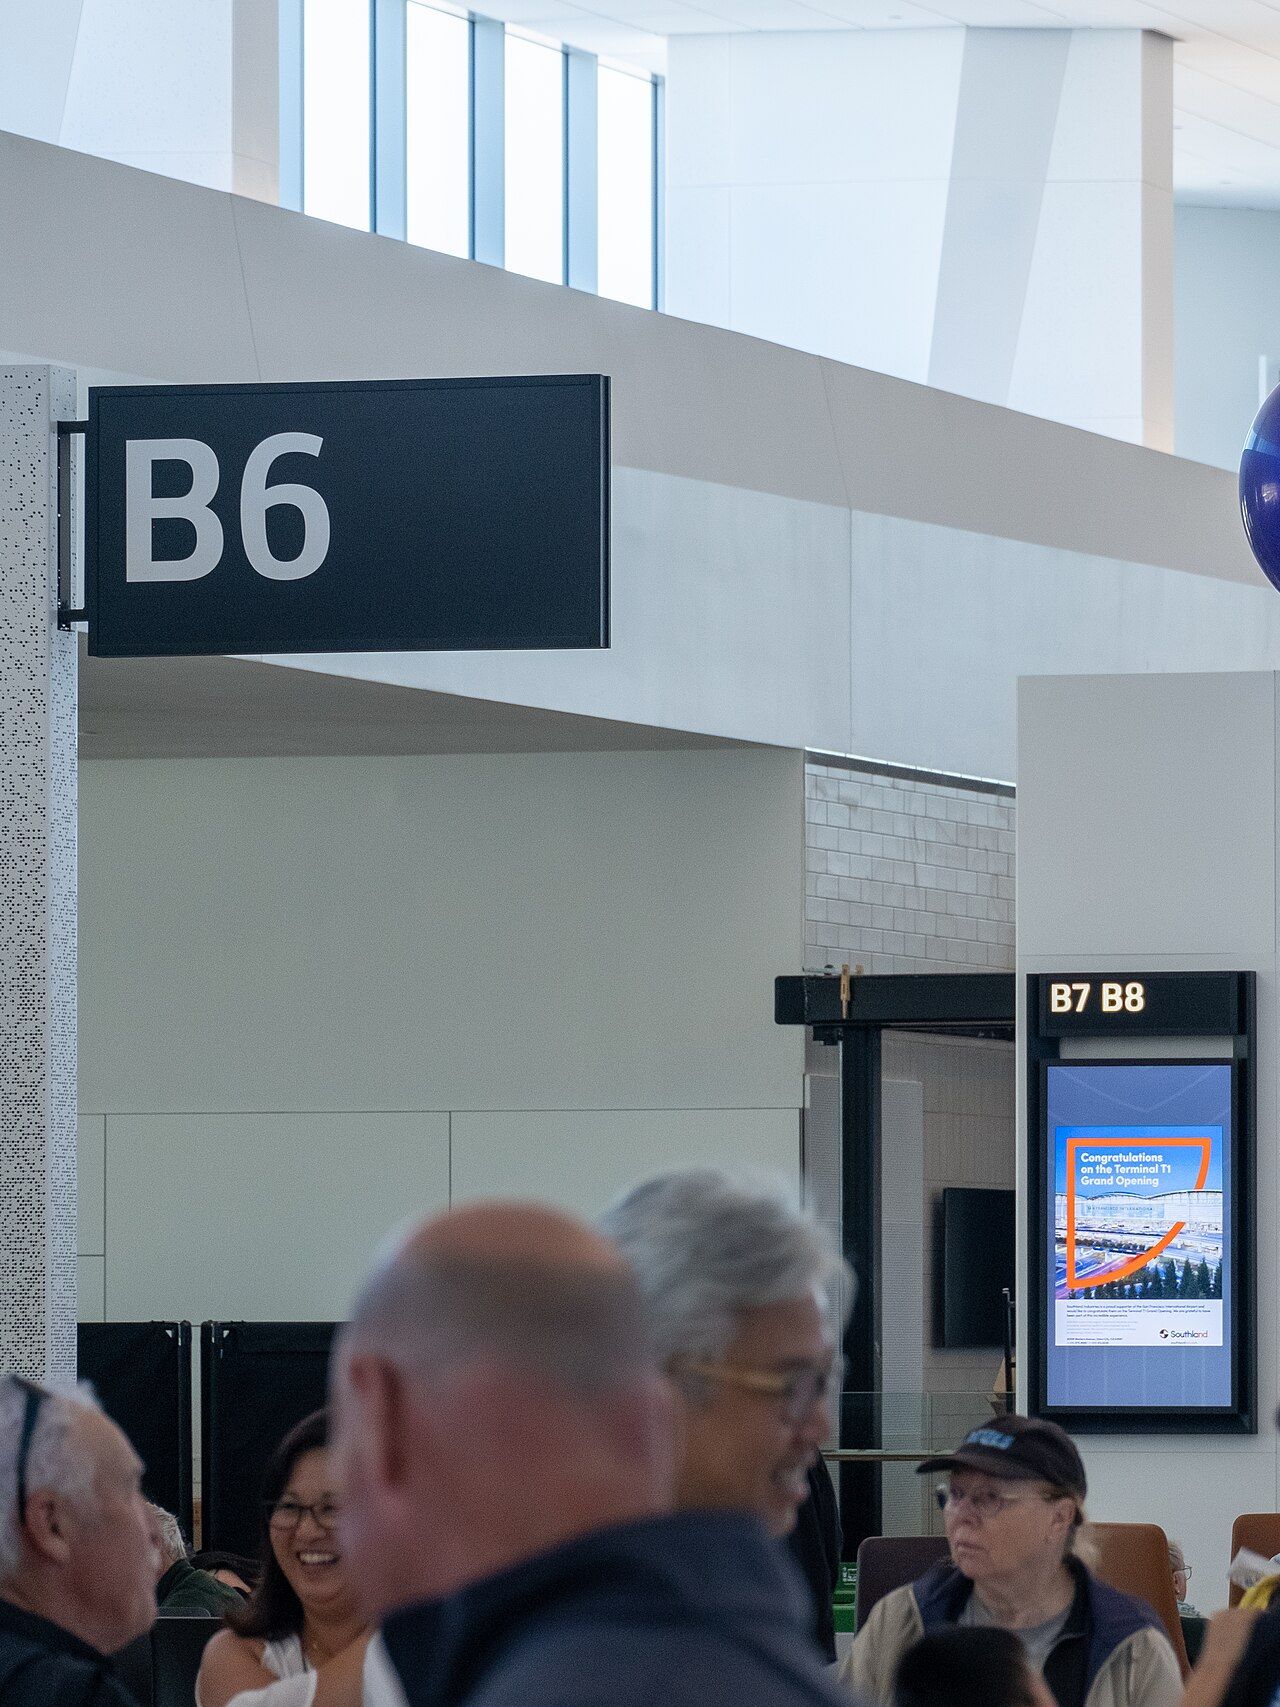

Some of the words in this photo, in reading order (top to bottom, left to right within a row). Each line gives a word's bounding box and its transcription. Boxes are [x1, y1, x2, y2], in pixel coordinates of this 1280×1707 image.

[125, 431, 332, 584] B6
[1050, 983, 1091, 1013] B7
[1101, 982, 1146, 1013] B8
[1080, 1152, 1163, 1164] Congratulations
[1080, 1165, 1094, 1174] on
[1095, 1164, 1113, 1174] the
[1114, 1164, 1159, 1173] Terminal
[1160, 1164, 1171, 1174] T1
[1080, 1175, 1114, 1186] Grand
[1115, 1175, 1159, 1187] Opening
[1170, 1330, 1208, 1338] Southland
